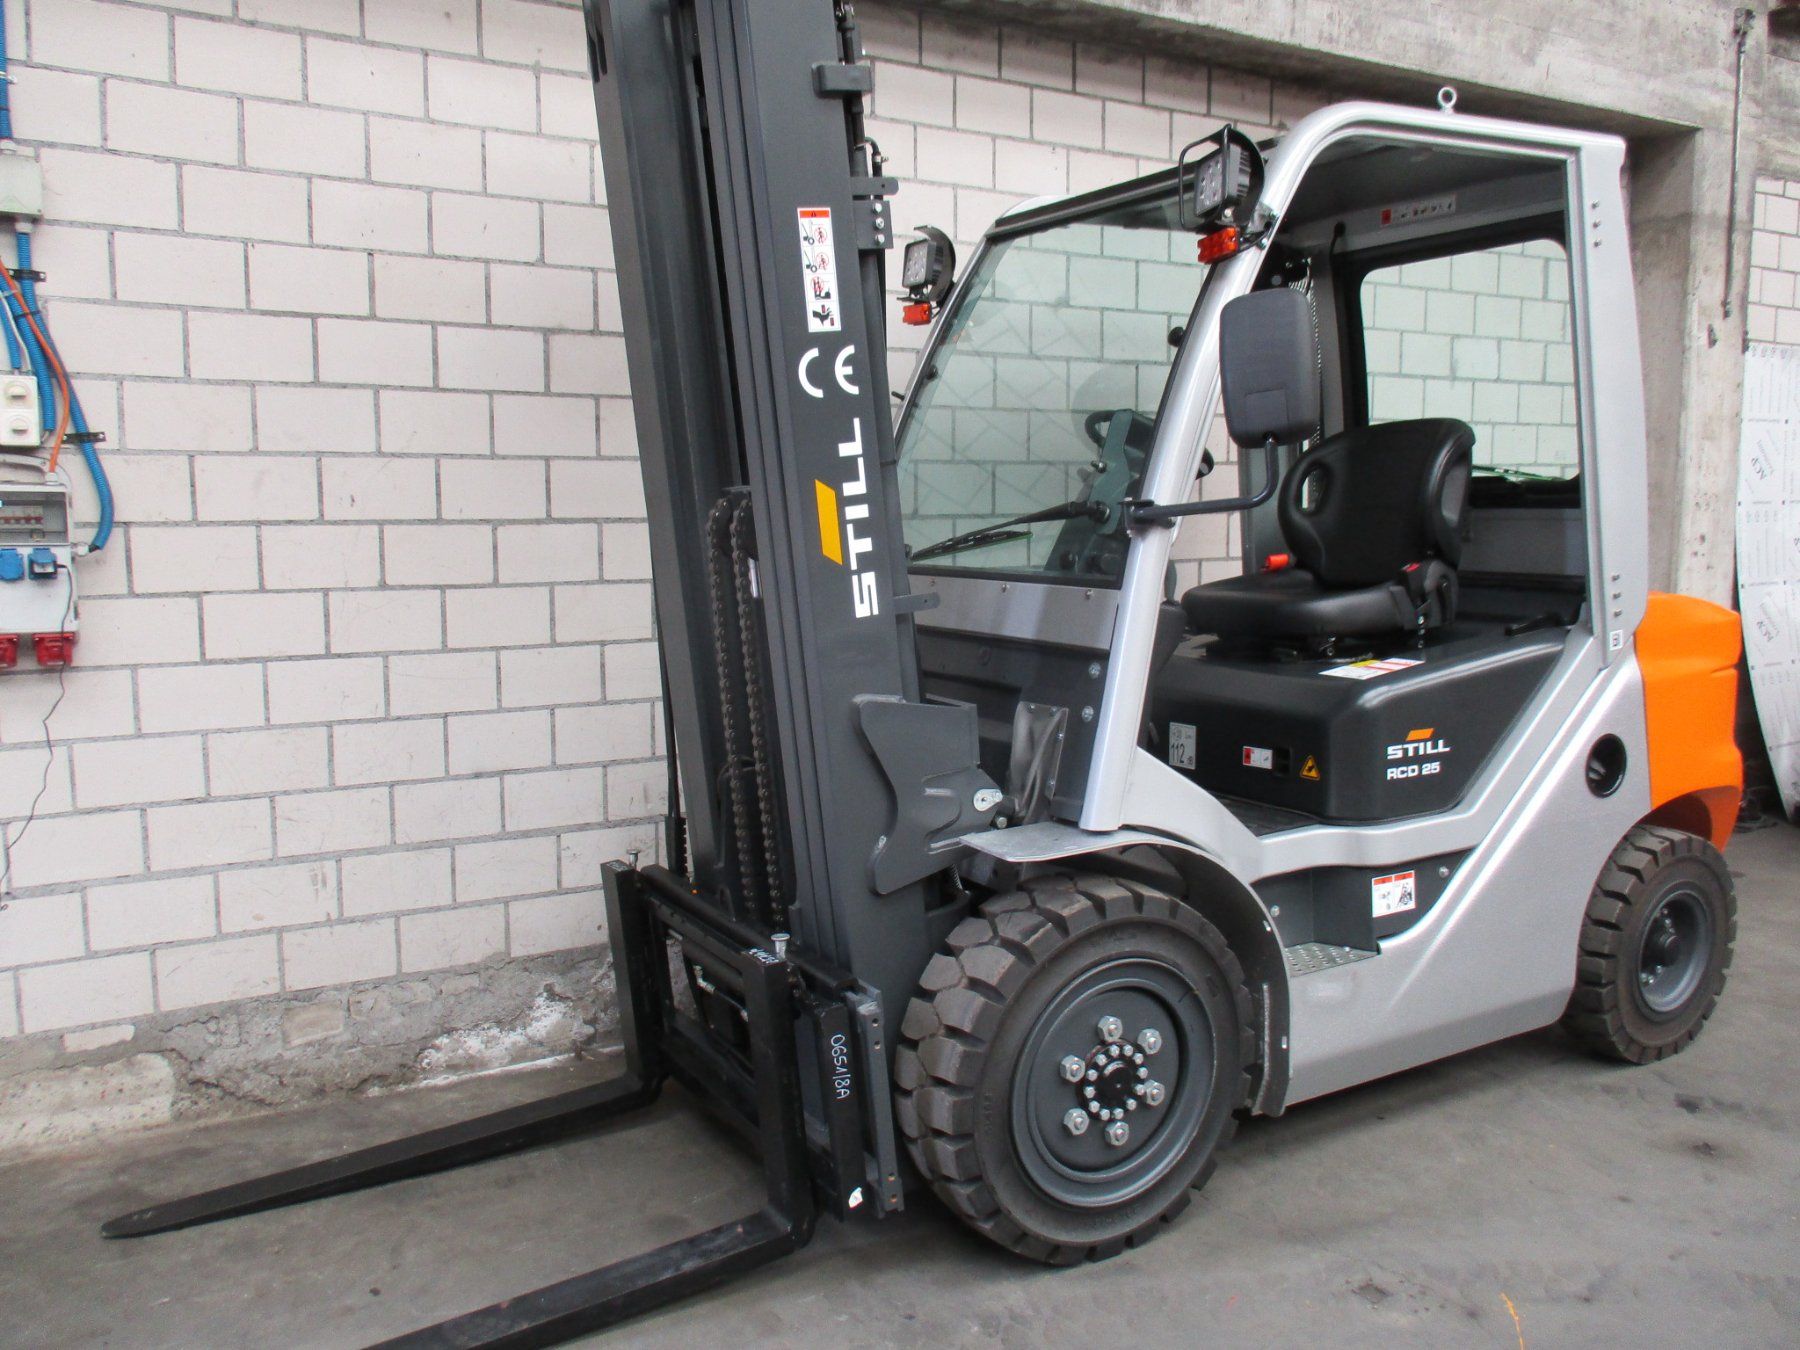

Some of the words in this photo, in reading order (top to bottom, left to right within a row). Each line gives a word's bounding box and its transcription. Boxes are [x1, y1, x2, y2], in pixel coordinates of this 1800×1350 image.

[798, 344, 859, 398] CE
[838, 417, 879, 618] STILL
[1170, 742, 1185, 764] 112
[1387, 739, 1451, 760] STILL
[1386, 765, 1419, 780] RCD
[1421, 761, 1441, 775] 25
